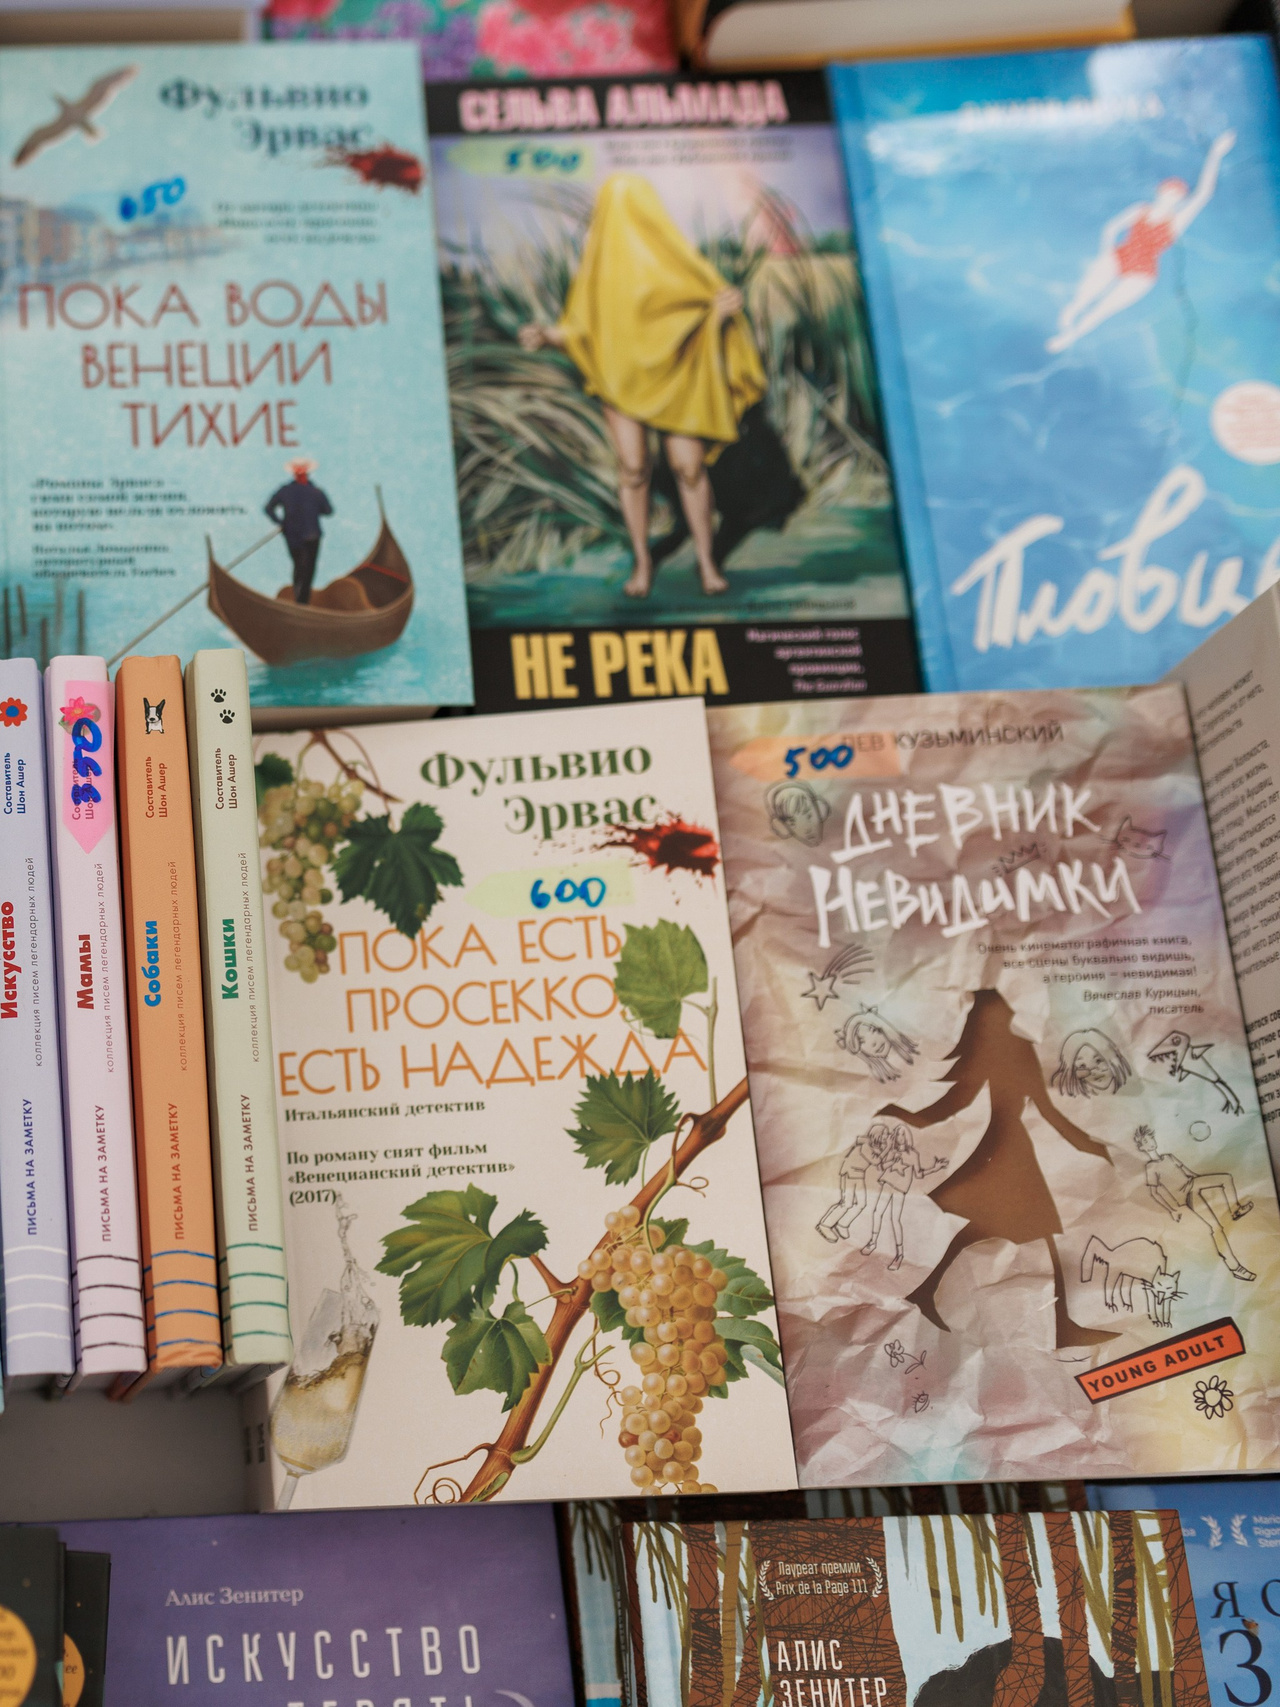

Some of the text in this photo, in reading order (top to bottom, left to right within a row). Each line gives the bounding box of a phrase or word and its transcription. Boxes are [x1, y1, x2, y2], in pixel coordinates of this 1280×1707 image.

[18, 279, 390, 332] ПОКА ВОДЫ
[81, 340, 333, 393] ВЕНЕЦИИ
[121, 400, 300, 449] ТИХИЕ
[510, 633, 578, 700] НЕ
[589, 628, 729, 698] РЕКА
[894, 720, 1065, 749] КУЗЬМИНСКИЙ
[4, 752, 13, 815] Составитель
[16, 759, 27, 814] Шон Ашер
[420, 745, 652, 796] Фульвио
[784, 744, 854, 779] 500
[505, 794, 658, 840] Эрвас
[830, 782, 1102, 864] ДНЕВНИК
[25, 857, 35, 891] людей
[530, 876, 607, 910] 600
[29, 896, 39, 967] легендарных
[337, 914, 622, 975] ПОКА ЕСТЬ
[1152, 935, 1192, 947] книга,
[0, 901, 22, 1019] Искусство
[76, 934, 94, 1010] Мамы
[141, 920, 161, 1007] Собаки
[221, 918, 239, 1000] Кошки
[1148, 1004, 1205, 1016] писатель
[33, 1009, 43, 1066] коллекция
[279, 1028, 708, 1097] ЕСТЬ НАДЕЖДА
[285, 1100, 486, 1123] Итальянский детектив
[22, 1098, 37, 1235] ПИСЬМА НА ЗАМЕТКУ
[241, 1094, 258, 1232] ПИСЬМА НА ЗАМЕТКУ
[286, 1143, 488, 1166] По роману снят фильм
[288, 1161, 516, 1185] «Венецианский детектив»
[289, 1189, 337, 1208] (2017)
[1087, 1334, 1227, 1393] YOUNG ADULT
[776, 1581, 796, 1595] Prix
[798, 1580, 810, 1594] de
[814, 1580, 822, 1594] la
[825, 1579, 849, 1596] Page
[778, 1561, 862, 1578] Лауреат премии
[165, 1586, 304, 1607] Алис Зенитер
[166, 1624, 482, 1686] ИСКУССТВО
[778, 1640, 843, 1672] АЛИС
[780, 1677, 888, 1707] ЗЕНИТЕР
